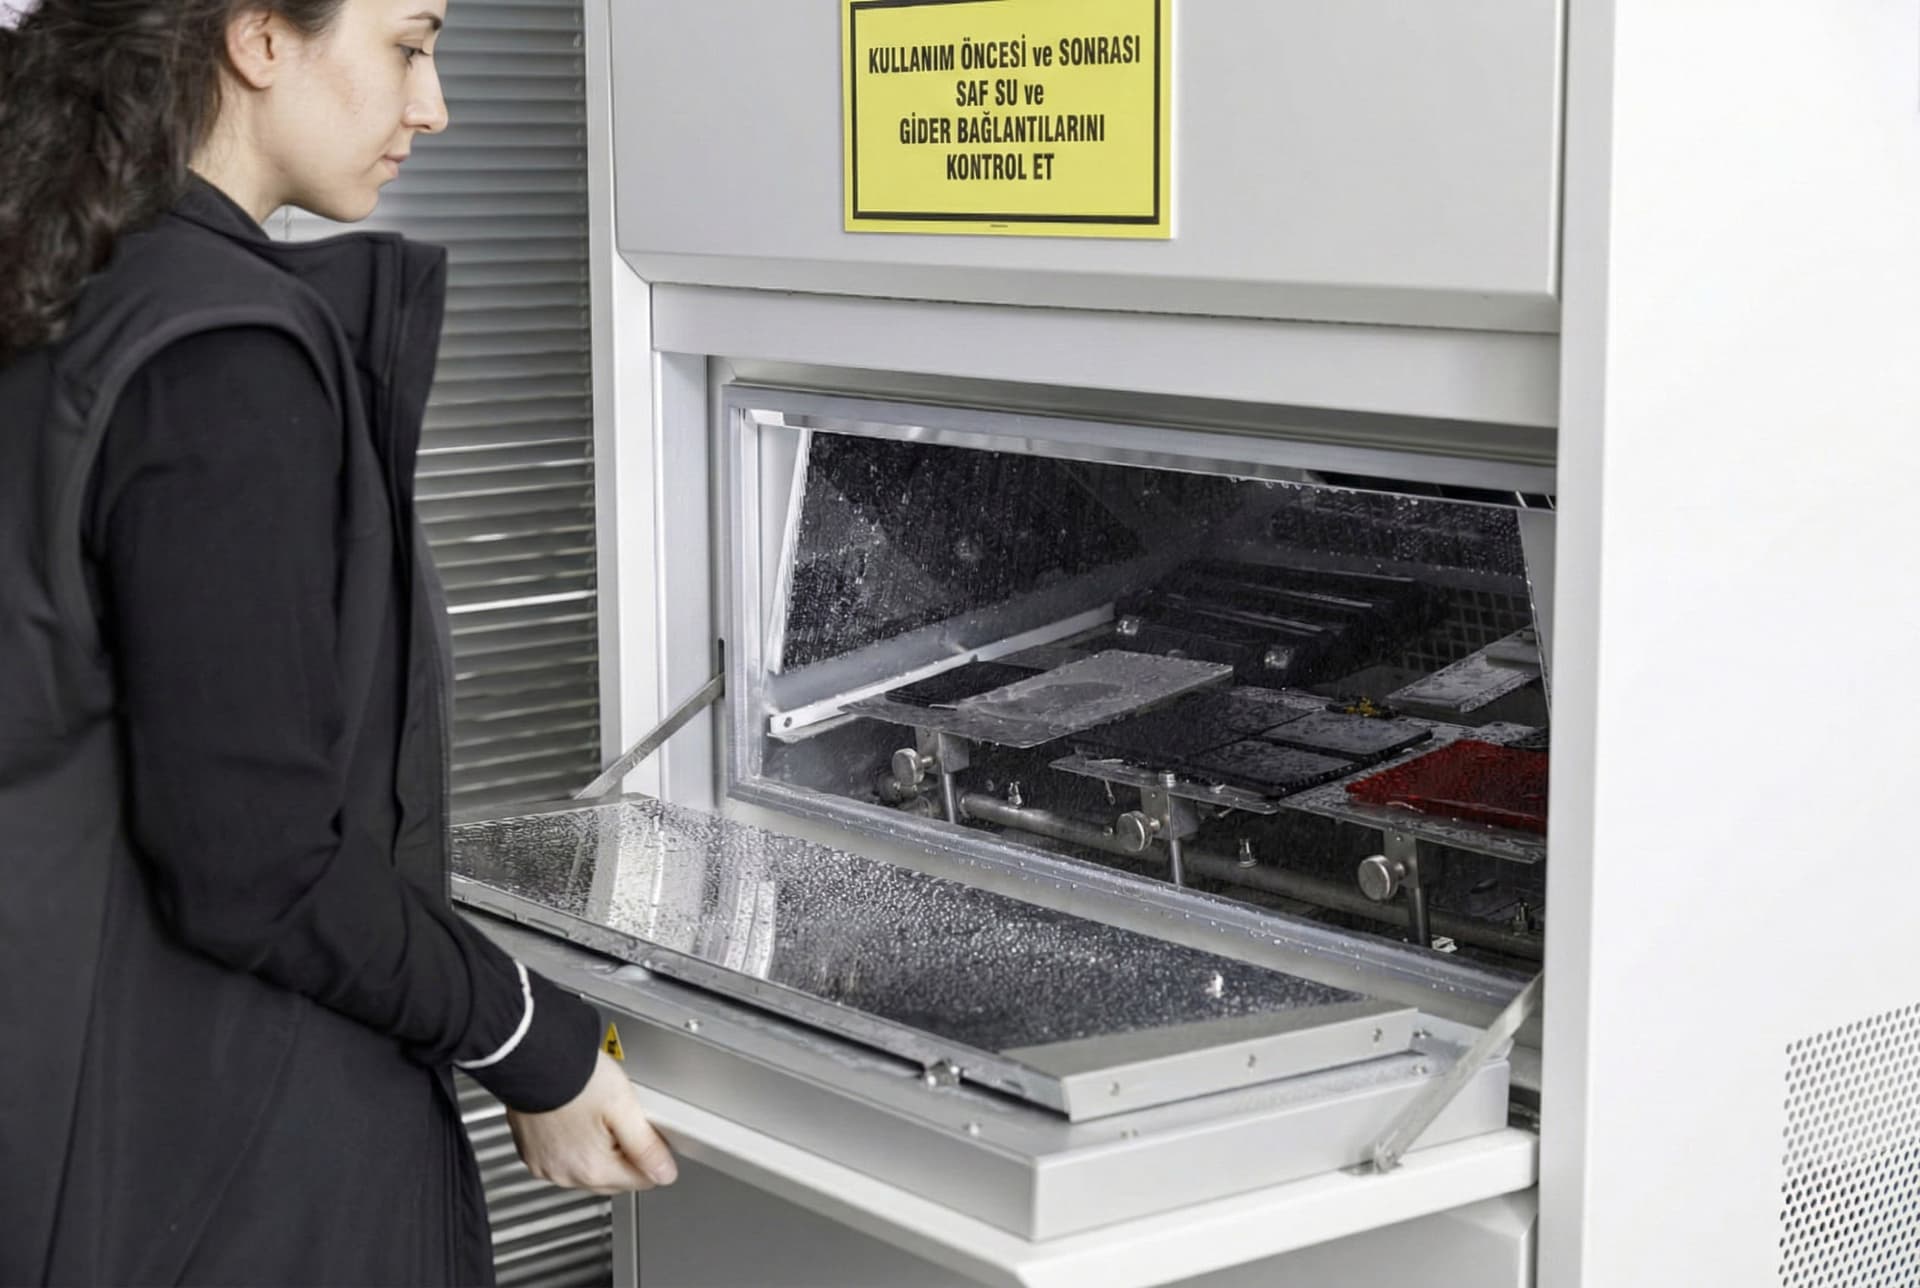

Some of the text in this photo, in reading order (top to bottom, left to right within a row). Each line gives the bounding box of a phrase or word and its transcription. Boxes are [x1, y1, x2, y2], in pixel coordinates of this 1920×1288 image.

[869, 34, 1140, 74] KULLANIM ÖNCESİ ve SONRASI
[956, 79, 1044, 107] SAF SU ve
[900, 111, 1104, 144] GİDER BAĞLANTILARINI
[947, 153, 1054, 180] KONTROL ET
